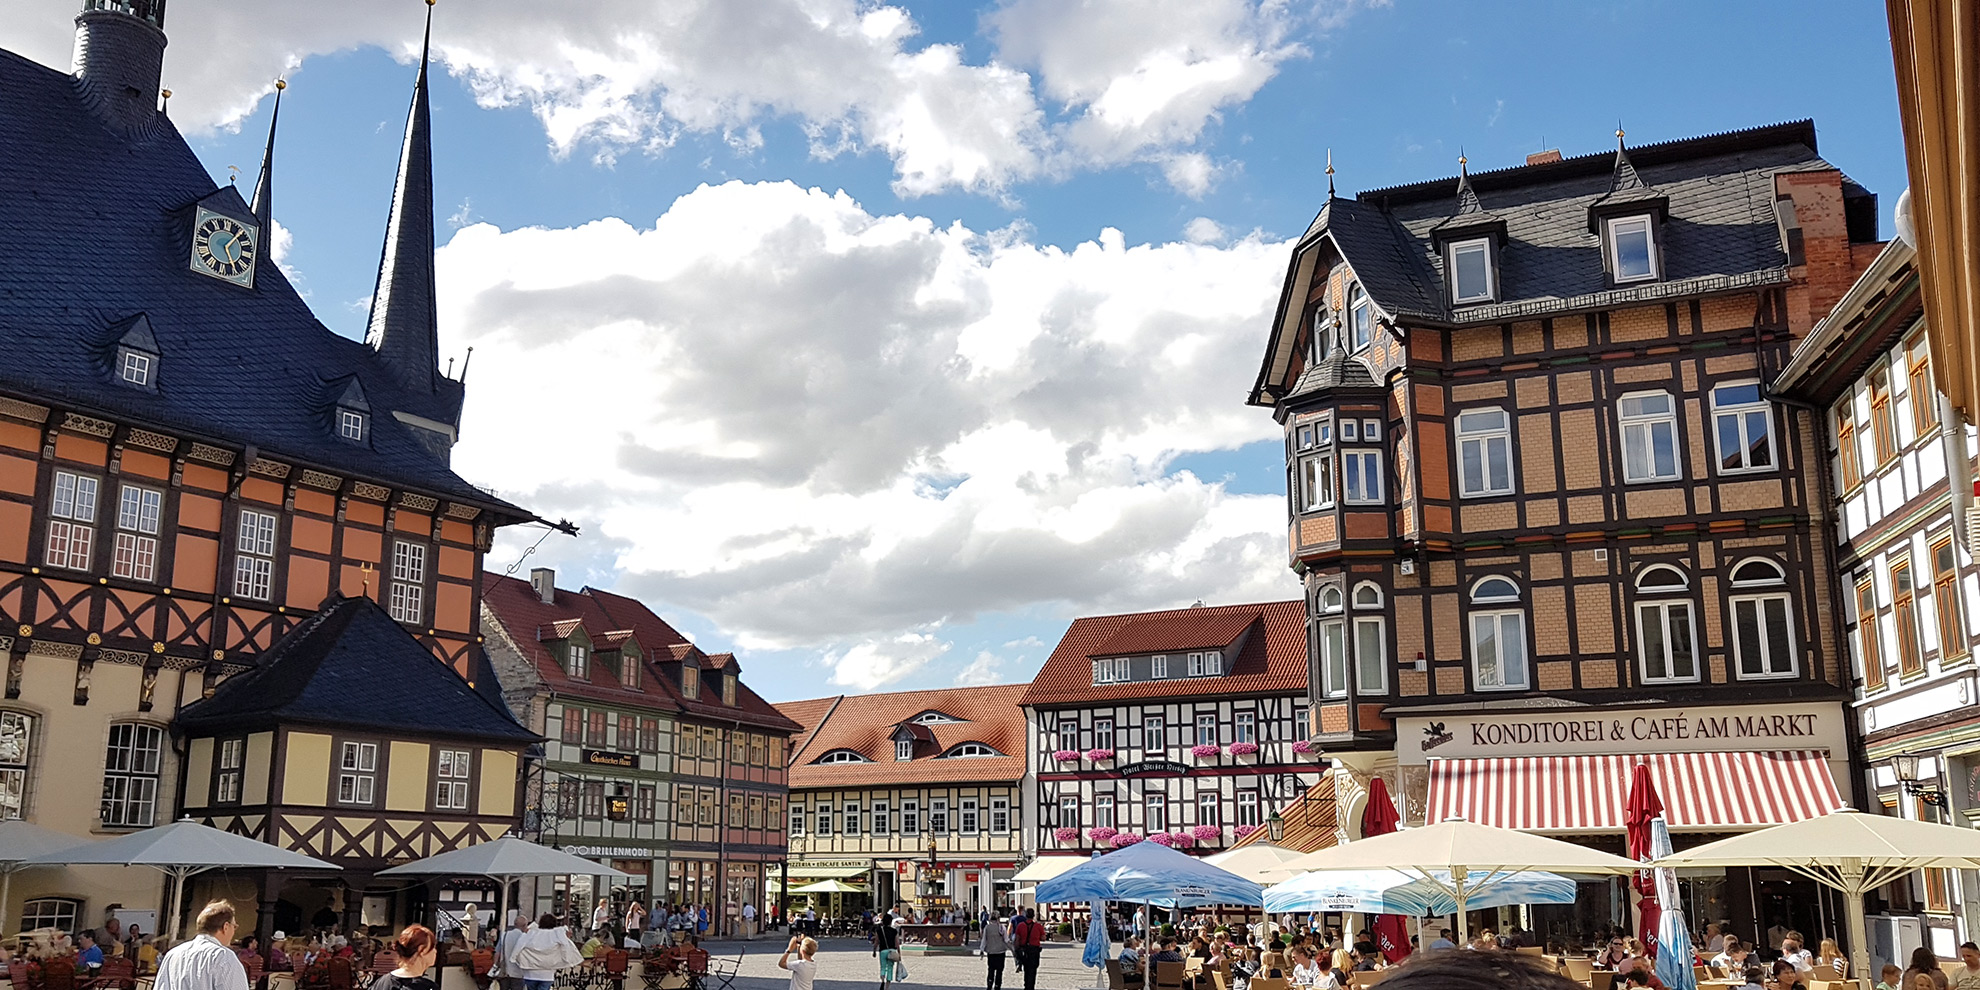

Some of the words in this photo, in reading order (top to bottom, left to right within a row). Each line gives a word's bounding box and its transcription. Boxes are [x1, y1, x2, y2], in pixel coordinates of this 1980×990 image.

[1471, 720, 1605, 746] KONDITOREI
[1611, 720, 1626, 742] &
[1631, 712, 1690, 742] CAFÉ
[1695, 716, 1730, 739] AM
[1735, 714, 1818, 738] MARKT
[591, 846, 648, 857] BRILLENMODE
